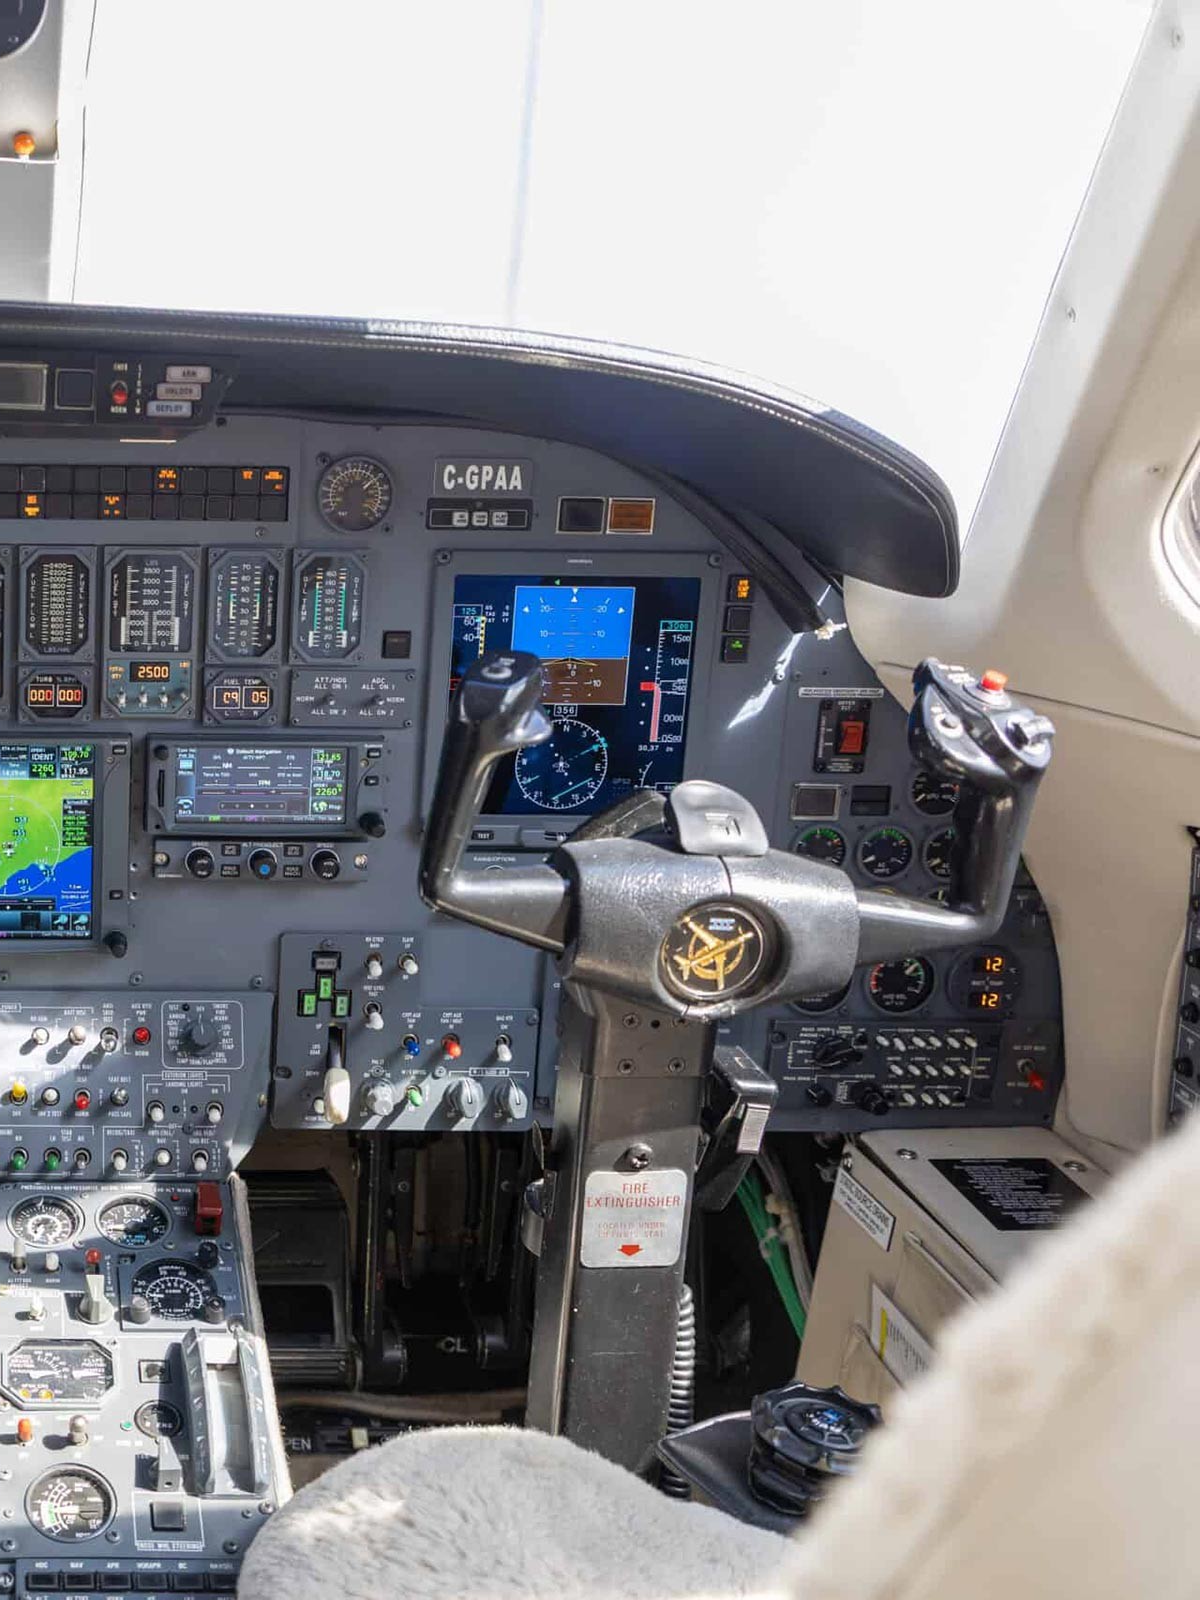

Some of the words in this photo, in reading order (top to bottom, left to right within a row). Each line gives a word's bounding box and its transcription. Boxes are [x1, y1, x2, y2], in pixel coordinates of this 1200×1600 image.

[443, 464, 523, 490] C-GPAA
[462, 607, 477, 615] 125
[540, 604, 550, 613] 20
[596, 605, 608, 613] 20
[463, 633, 474, 642] 40
[540, 630, 549, 638] 10
[597, 630, 606, 638] 10
[137, 666, 169, 679] 2500
[30, 689, 53, 701] 000
[58, 689, 82, 701] 000
[251, 691, 267, 703] 05
[31, 753, 54, 761] IDENT
[31, 763, 54, 772] 2260
[63, 767, 89, 775] 111.95
[315, 788, 337, 796] 2260
[985, 957, 1003, 972] 12
[981, 993, 999, 1008] 12
[622, 1182, 649, 1194] FIRE
[586, 1195, 681, 1208] EXTINGUISHER
